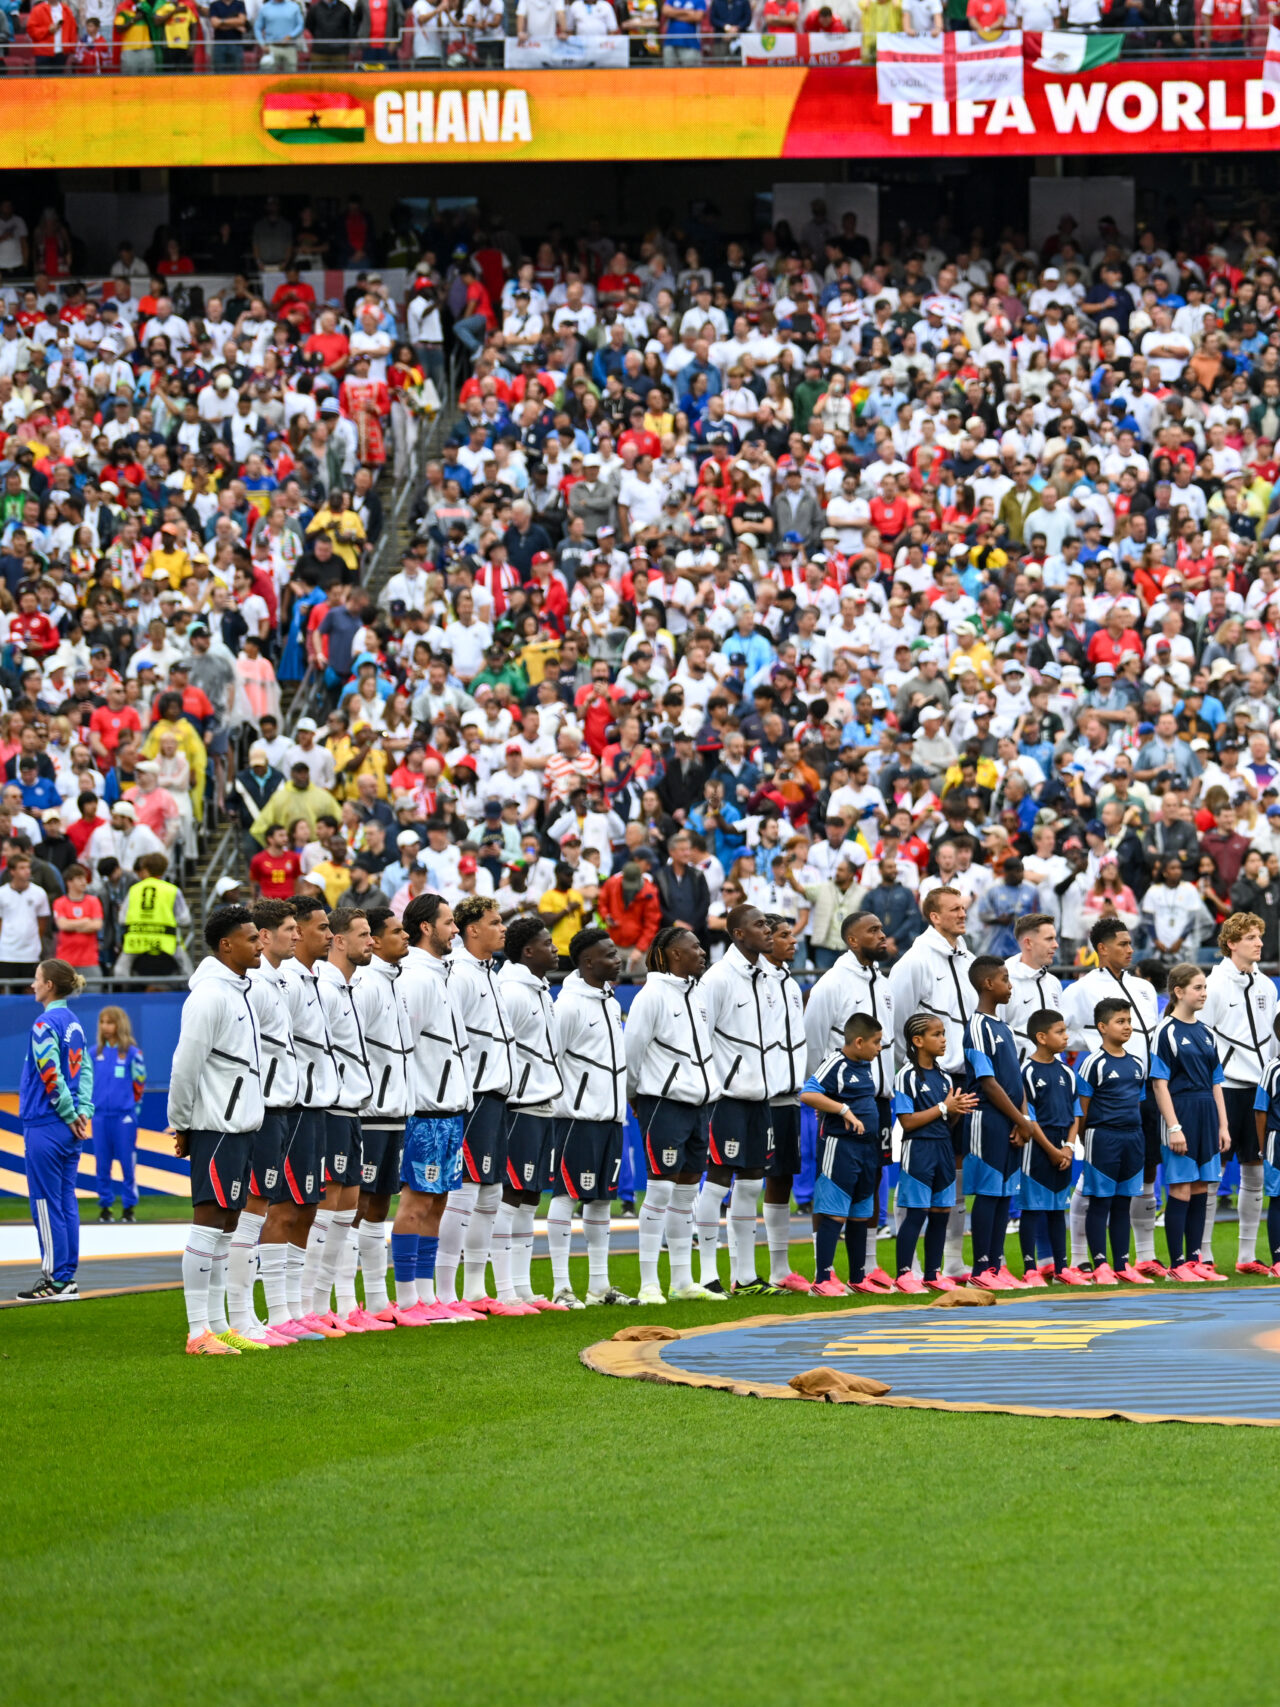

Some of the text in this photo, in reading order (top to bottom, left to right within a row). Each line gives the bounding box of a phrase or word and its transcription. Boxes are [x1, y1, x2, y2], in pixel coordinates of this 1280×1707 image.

[375, 90, 531, 143] GHANA
[891, 95, 1037, 135] FIFA
[1181, 157, 1256, 186] THE
[611, 1158, 622, 1183] 7
